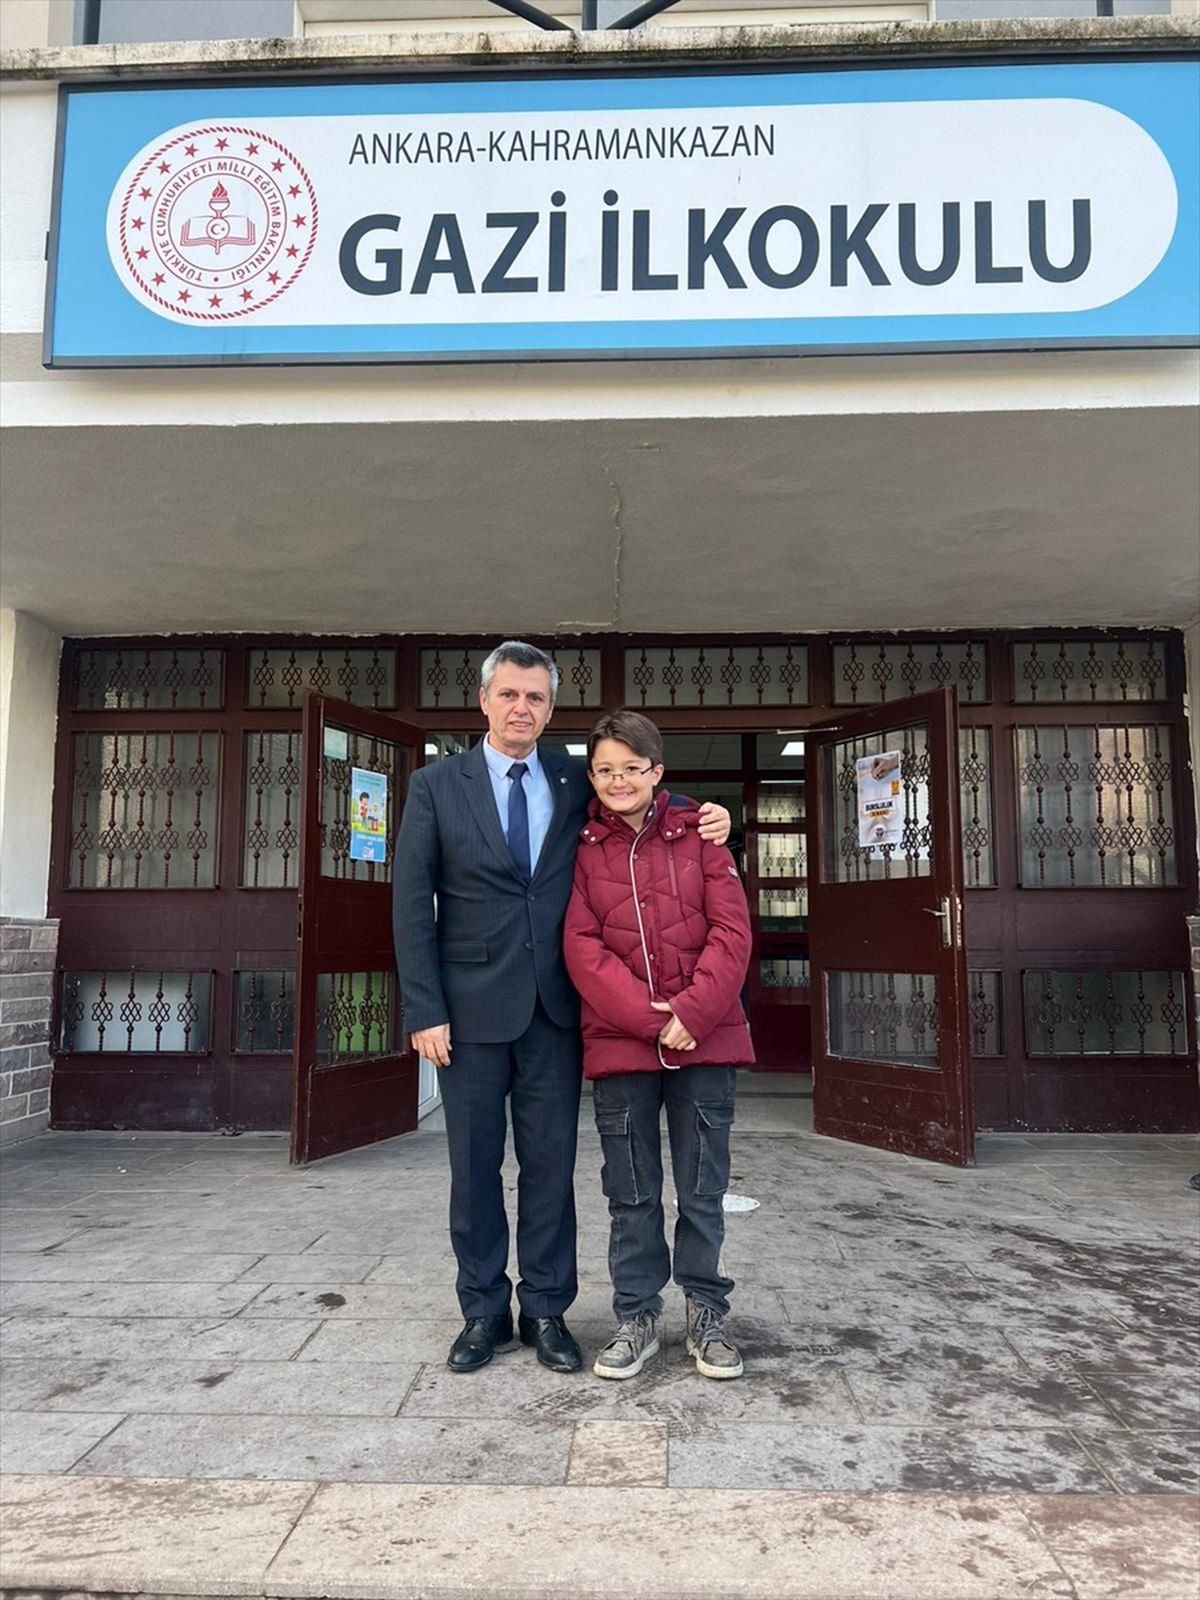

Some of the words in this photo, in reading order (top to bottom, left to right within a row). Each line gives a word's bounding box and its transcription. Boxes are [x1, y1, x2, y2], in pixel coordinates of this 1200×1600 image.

[349, 124, 775, 165] ANKARA-KAHRAMANKAZAN
[157, 162, 212, 235] CUMHURİYETİ
[254, 174, 281, 216] EĞİTİM
[160, 240, 202, 281] TÜRKİYE
[231, 222, 281, 280] BAKANLIĞI
[338, 190, 567, 296] GAZİ
[601, 189, 1092, 292] İLKOKULU
